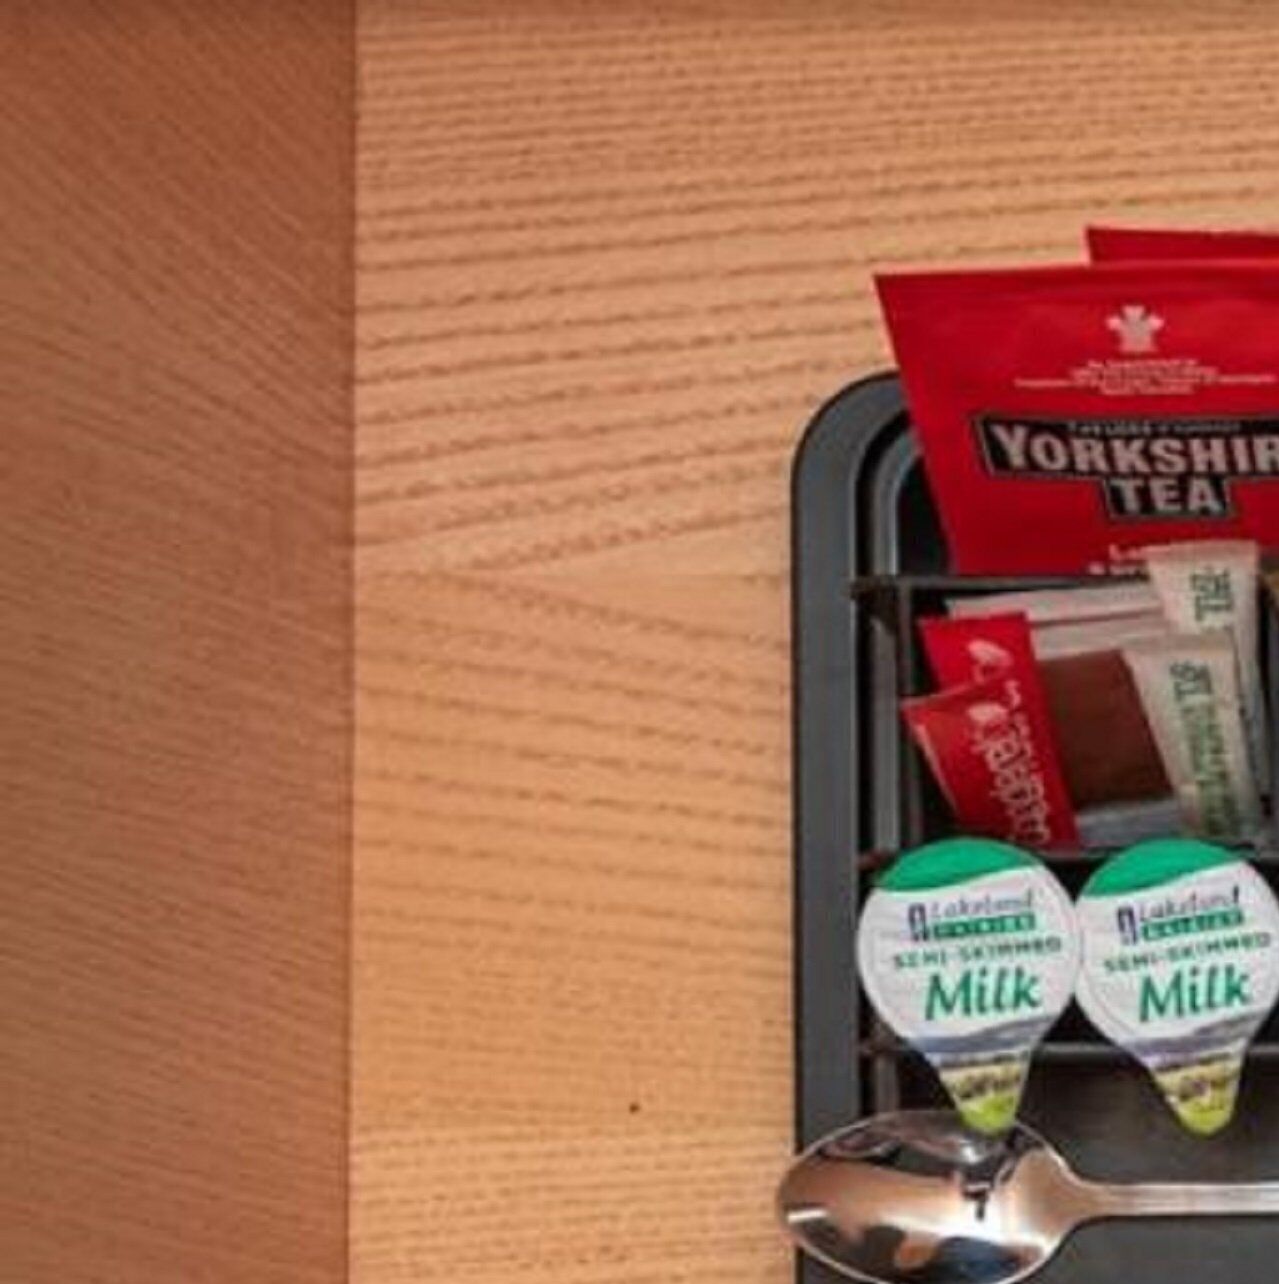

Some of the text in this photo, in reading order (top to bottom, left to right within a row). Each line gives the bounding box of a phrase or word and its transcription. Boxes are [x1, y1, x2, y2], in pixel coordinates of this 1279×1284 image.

[1110, 476, 1224, 514] TEA
[925, 966, 1042, 1021] Milk
[1138, 963, 1253, 1023] Milk
